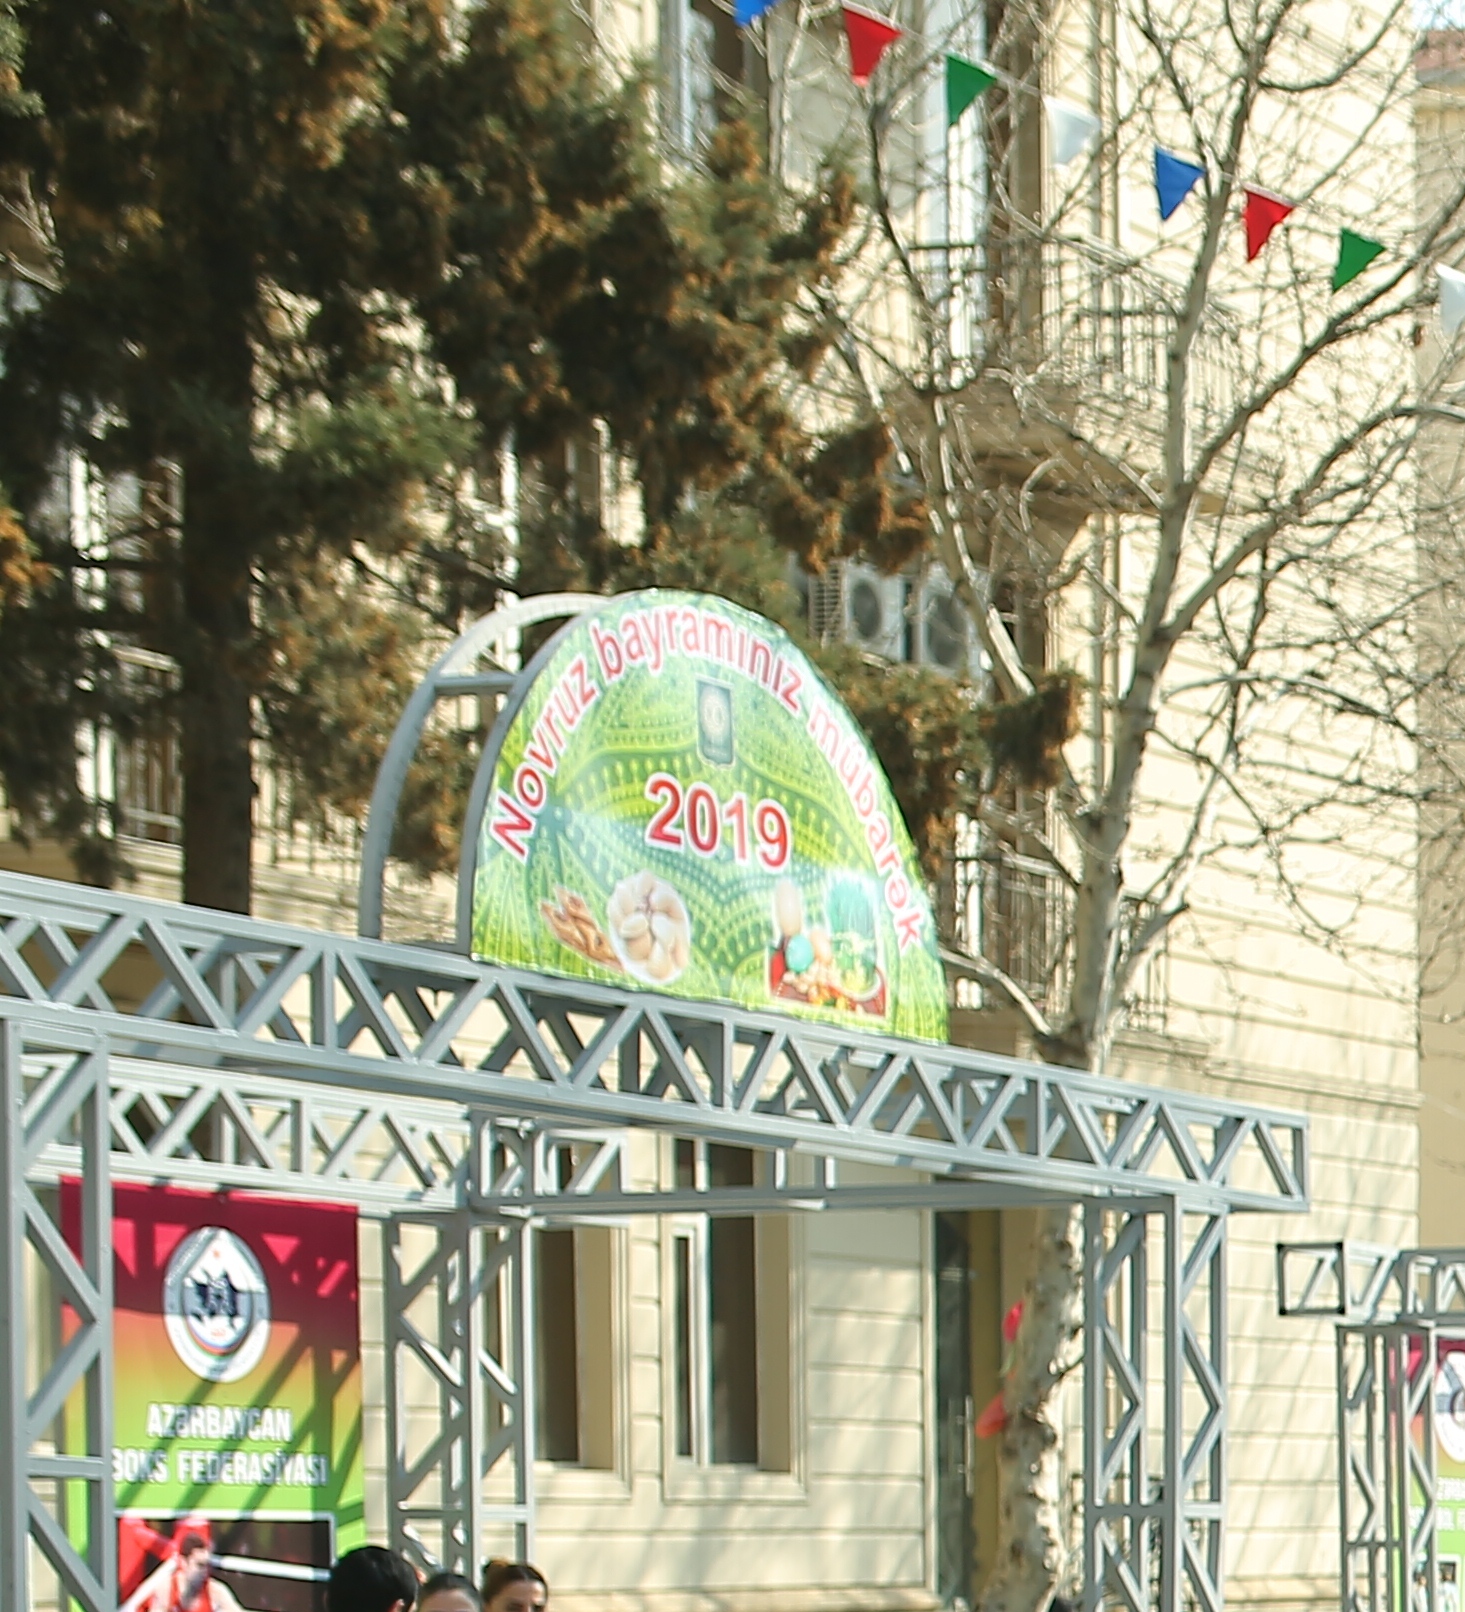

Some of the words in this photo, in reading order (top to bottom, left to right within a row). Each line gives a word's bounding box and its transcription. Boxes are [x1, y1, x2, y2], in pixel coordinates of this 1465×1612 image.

[491, 664, 596, 858] Novruz
[593, 606, 804, 716] bayramınız
[807, 700, 923, 953] mübarək
[645, 774, 790, 869] 2019
